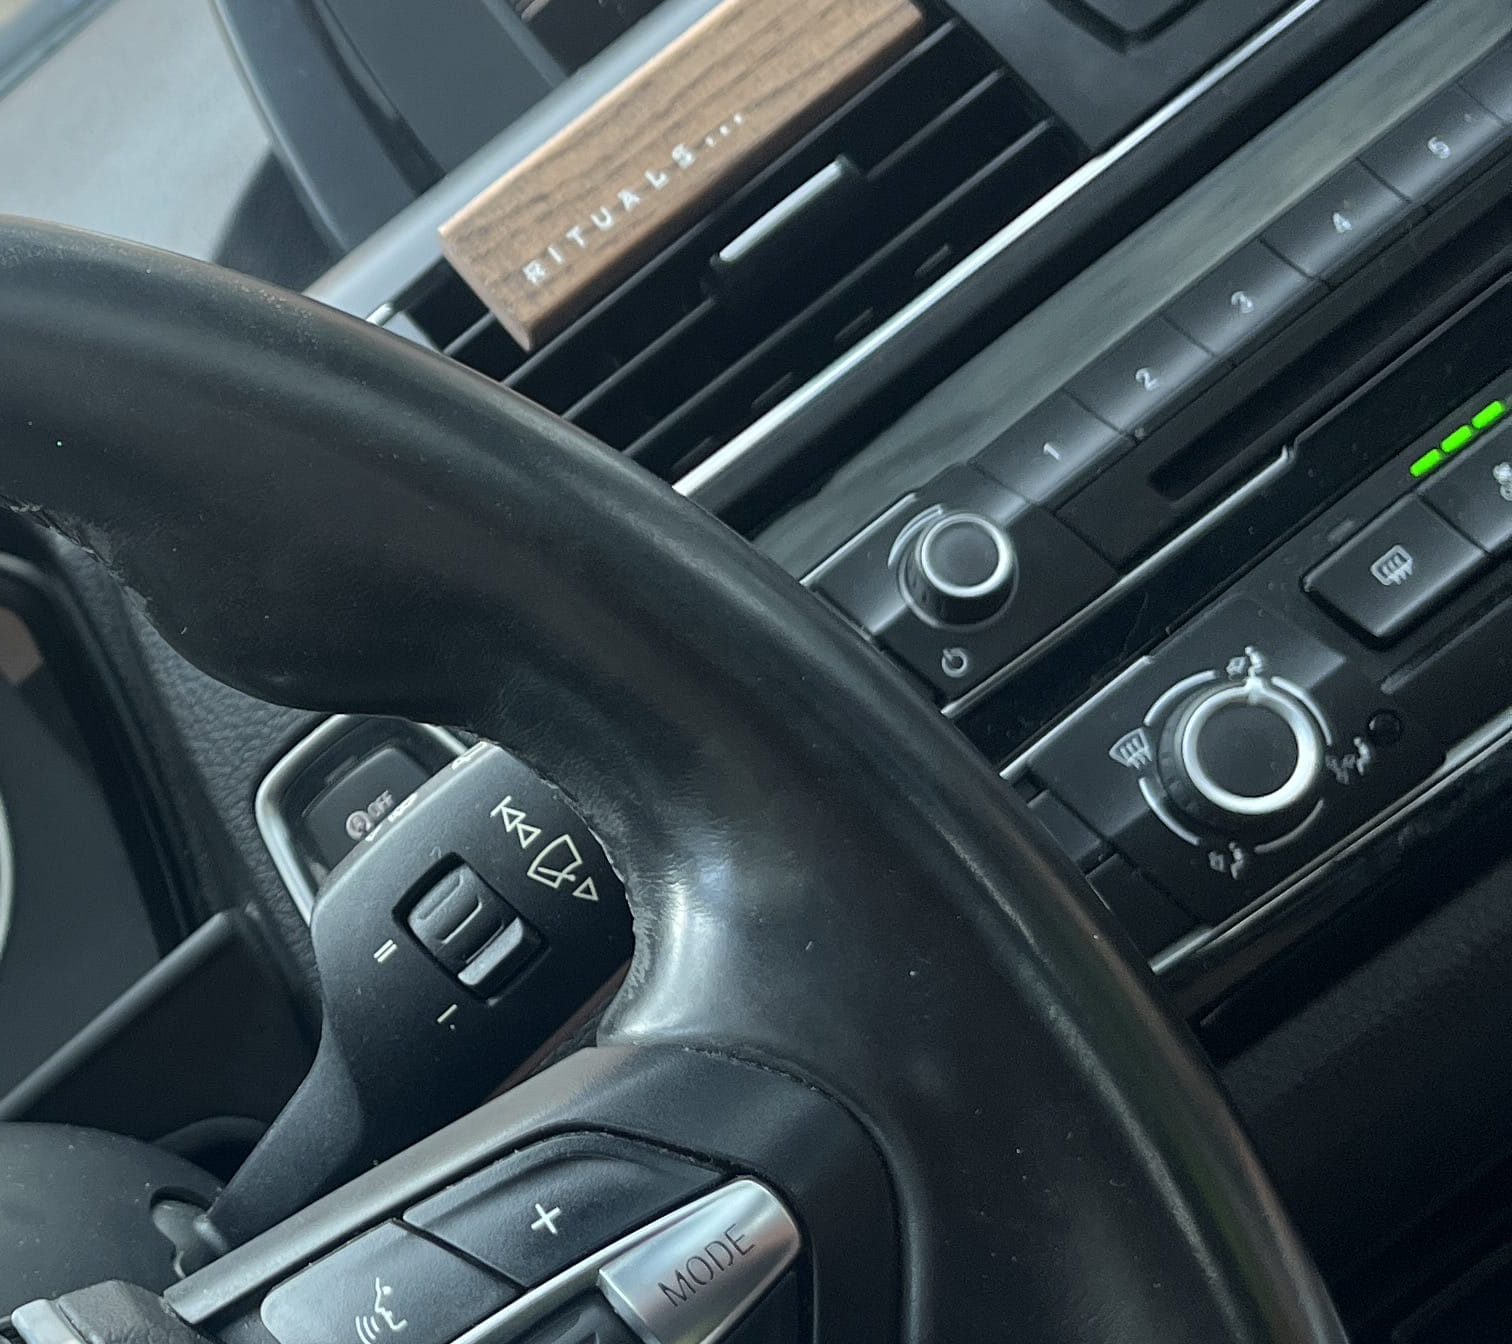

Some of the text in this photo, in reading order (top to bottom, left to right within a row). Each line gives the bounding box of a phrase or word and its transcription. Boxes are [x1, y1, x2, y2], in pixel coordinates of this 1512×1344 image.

[1331, 211, 1353, 234] 4
[1230, 290, 1256, 315] 3
[1134, 367, 1160, 392] 2
[1042, 441, 1062, 462] 1
[656, 1222, 756, 1311] MODE
